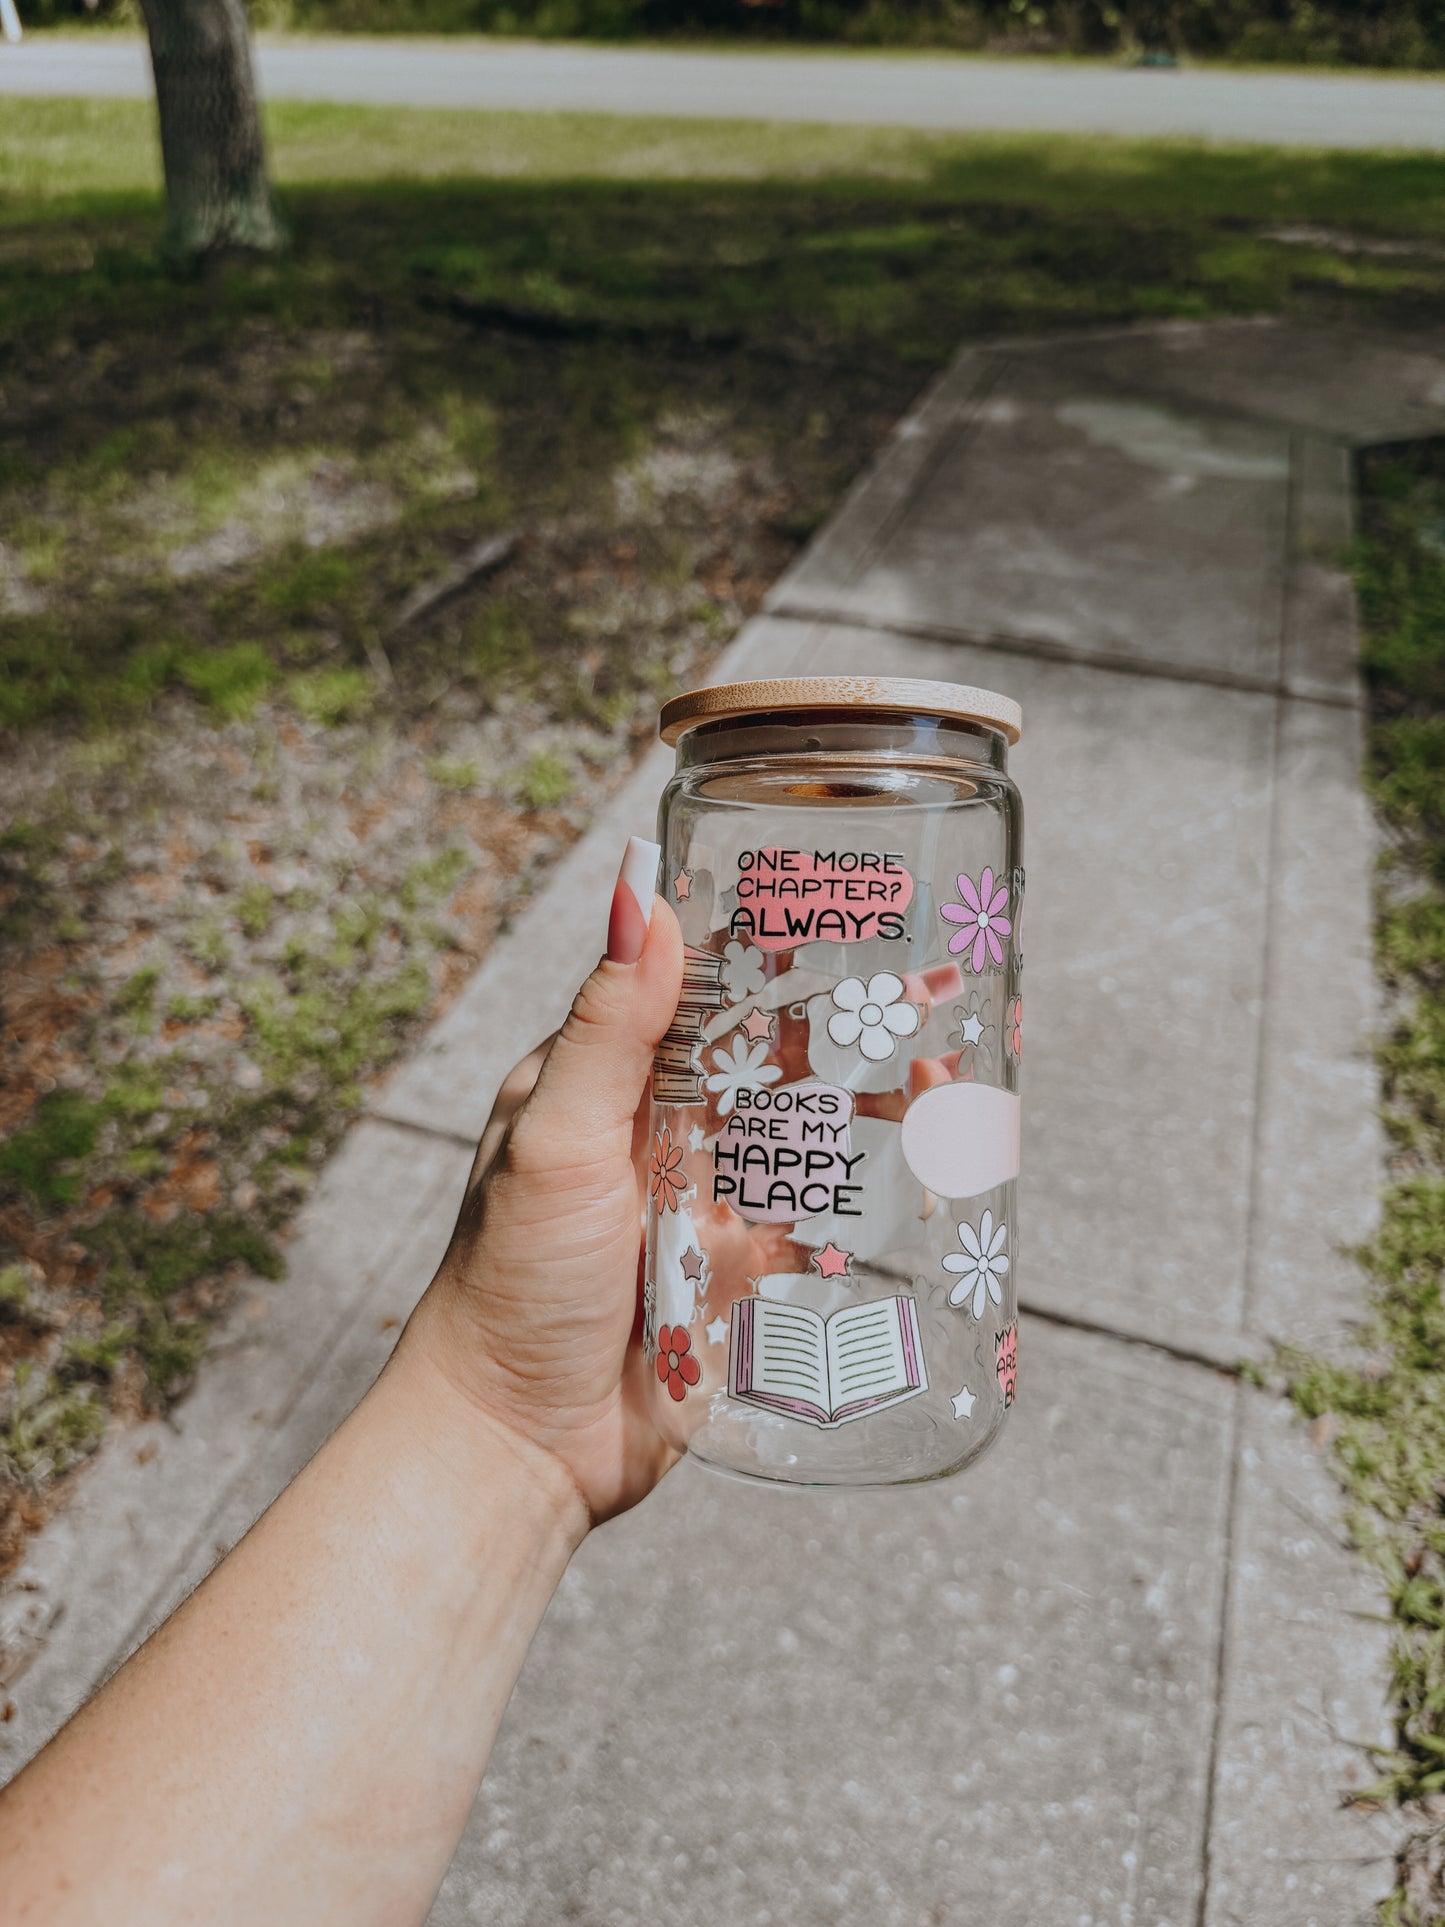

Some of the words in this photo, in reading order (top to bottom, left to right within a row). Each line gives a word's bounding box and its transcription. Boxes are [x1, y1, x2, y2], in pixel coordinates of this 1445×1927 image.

[738, 850, 801, 871] ONE
[813, 850, 904, 875] MORE
[737, 877, 902, 902] CHAPTER?
[731, 907, 912, 942] ALWAYS.
[736, 1088, 839, 1114] BOOKS
[728, 1115, 789, 1140] ARE
[802, 1120, 847, 1143] MY
[714, 1140, 866, 1180] HAPPY
[713, 1175, 864, 1216] PLACE
